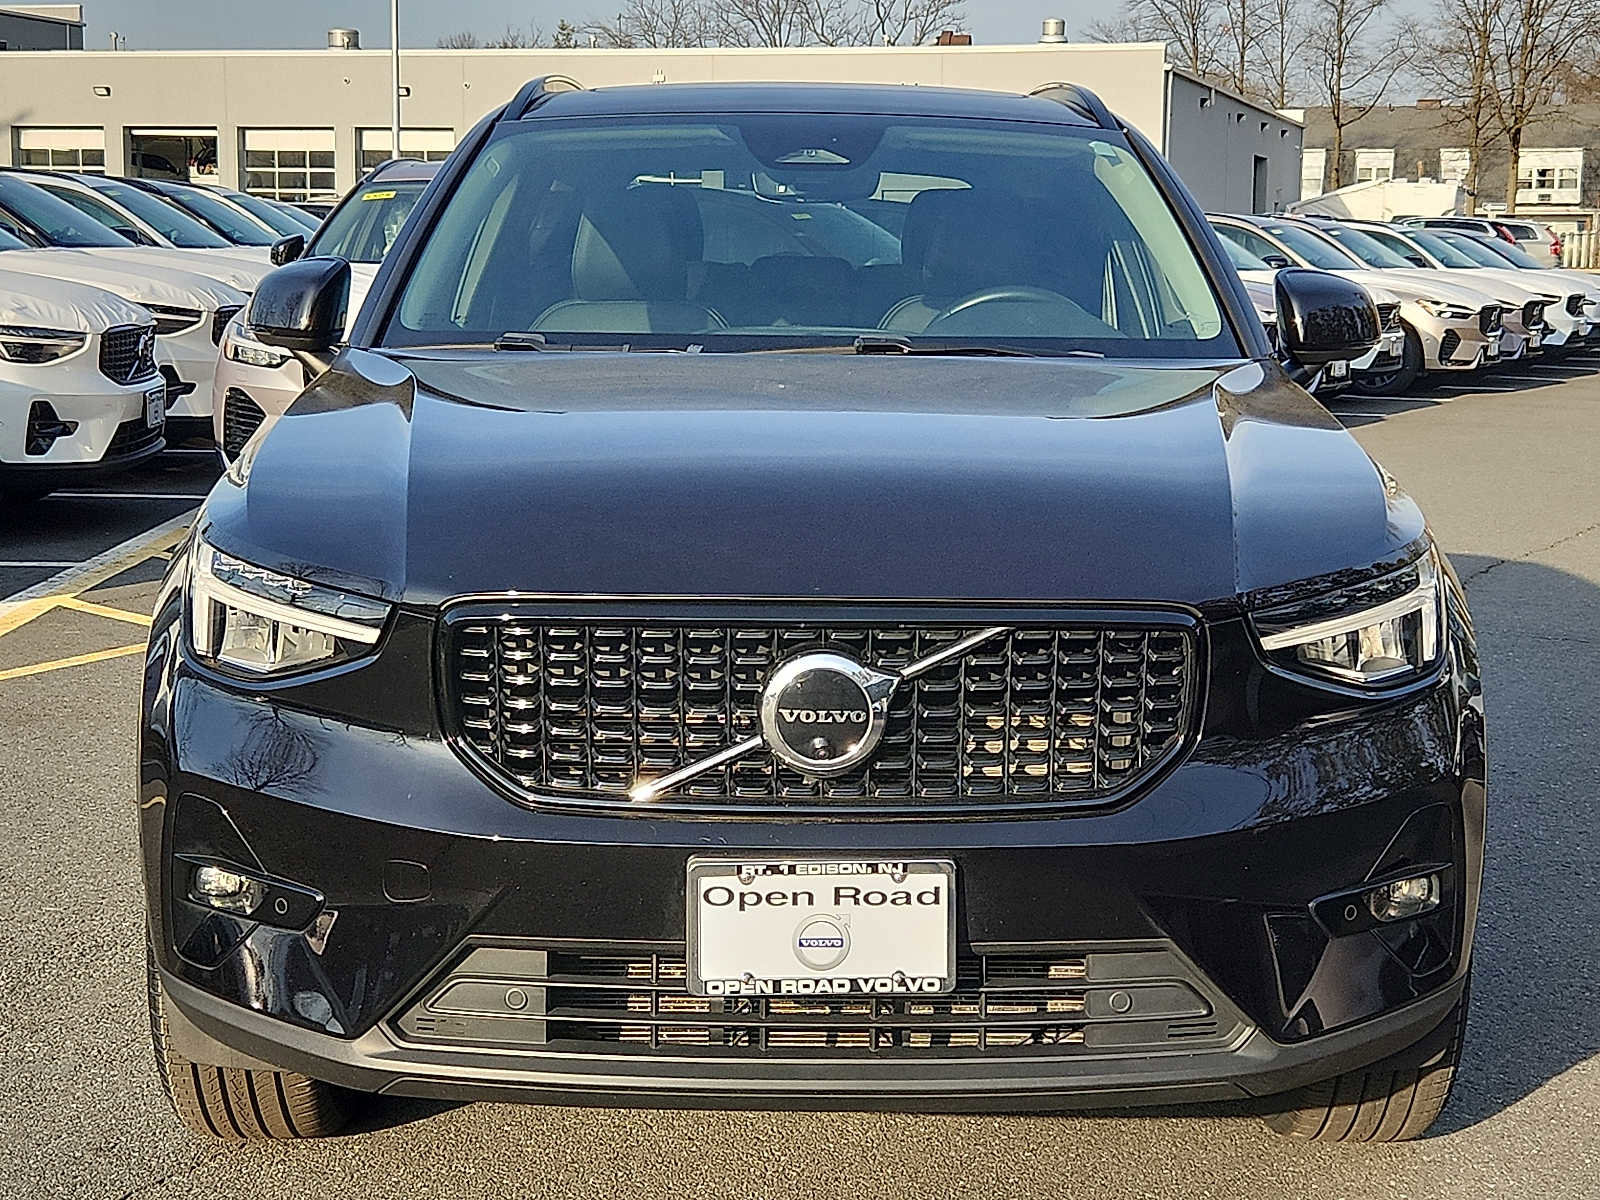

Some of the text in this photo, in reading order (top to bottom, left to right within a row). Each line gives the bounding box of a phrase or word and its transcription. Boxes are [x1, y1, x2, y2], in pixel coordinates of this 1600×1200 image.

[778, 709, 867, 723] VOLVO
[741, 864, 772, 876] RT.
[779, 864, 789, 875] 1
[878, 862, 904, 876] NJ
[703, 886, 941, 911] Open Road
[800, 939, 842, 947] VOLVO
[706, 977, 941, 995] OPEN ROAD VOLVO
